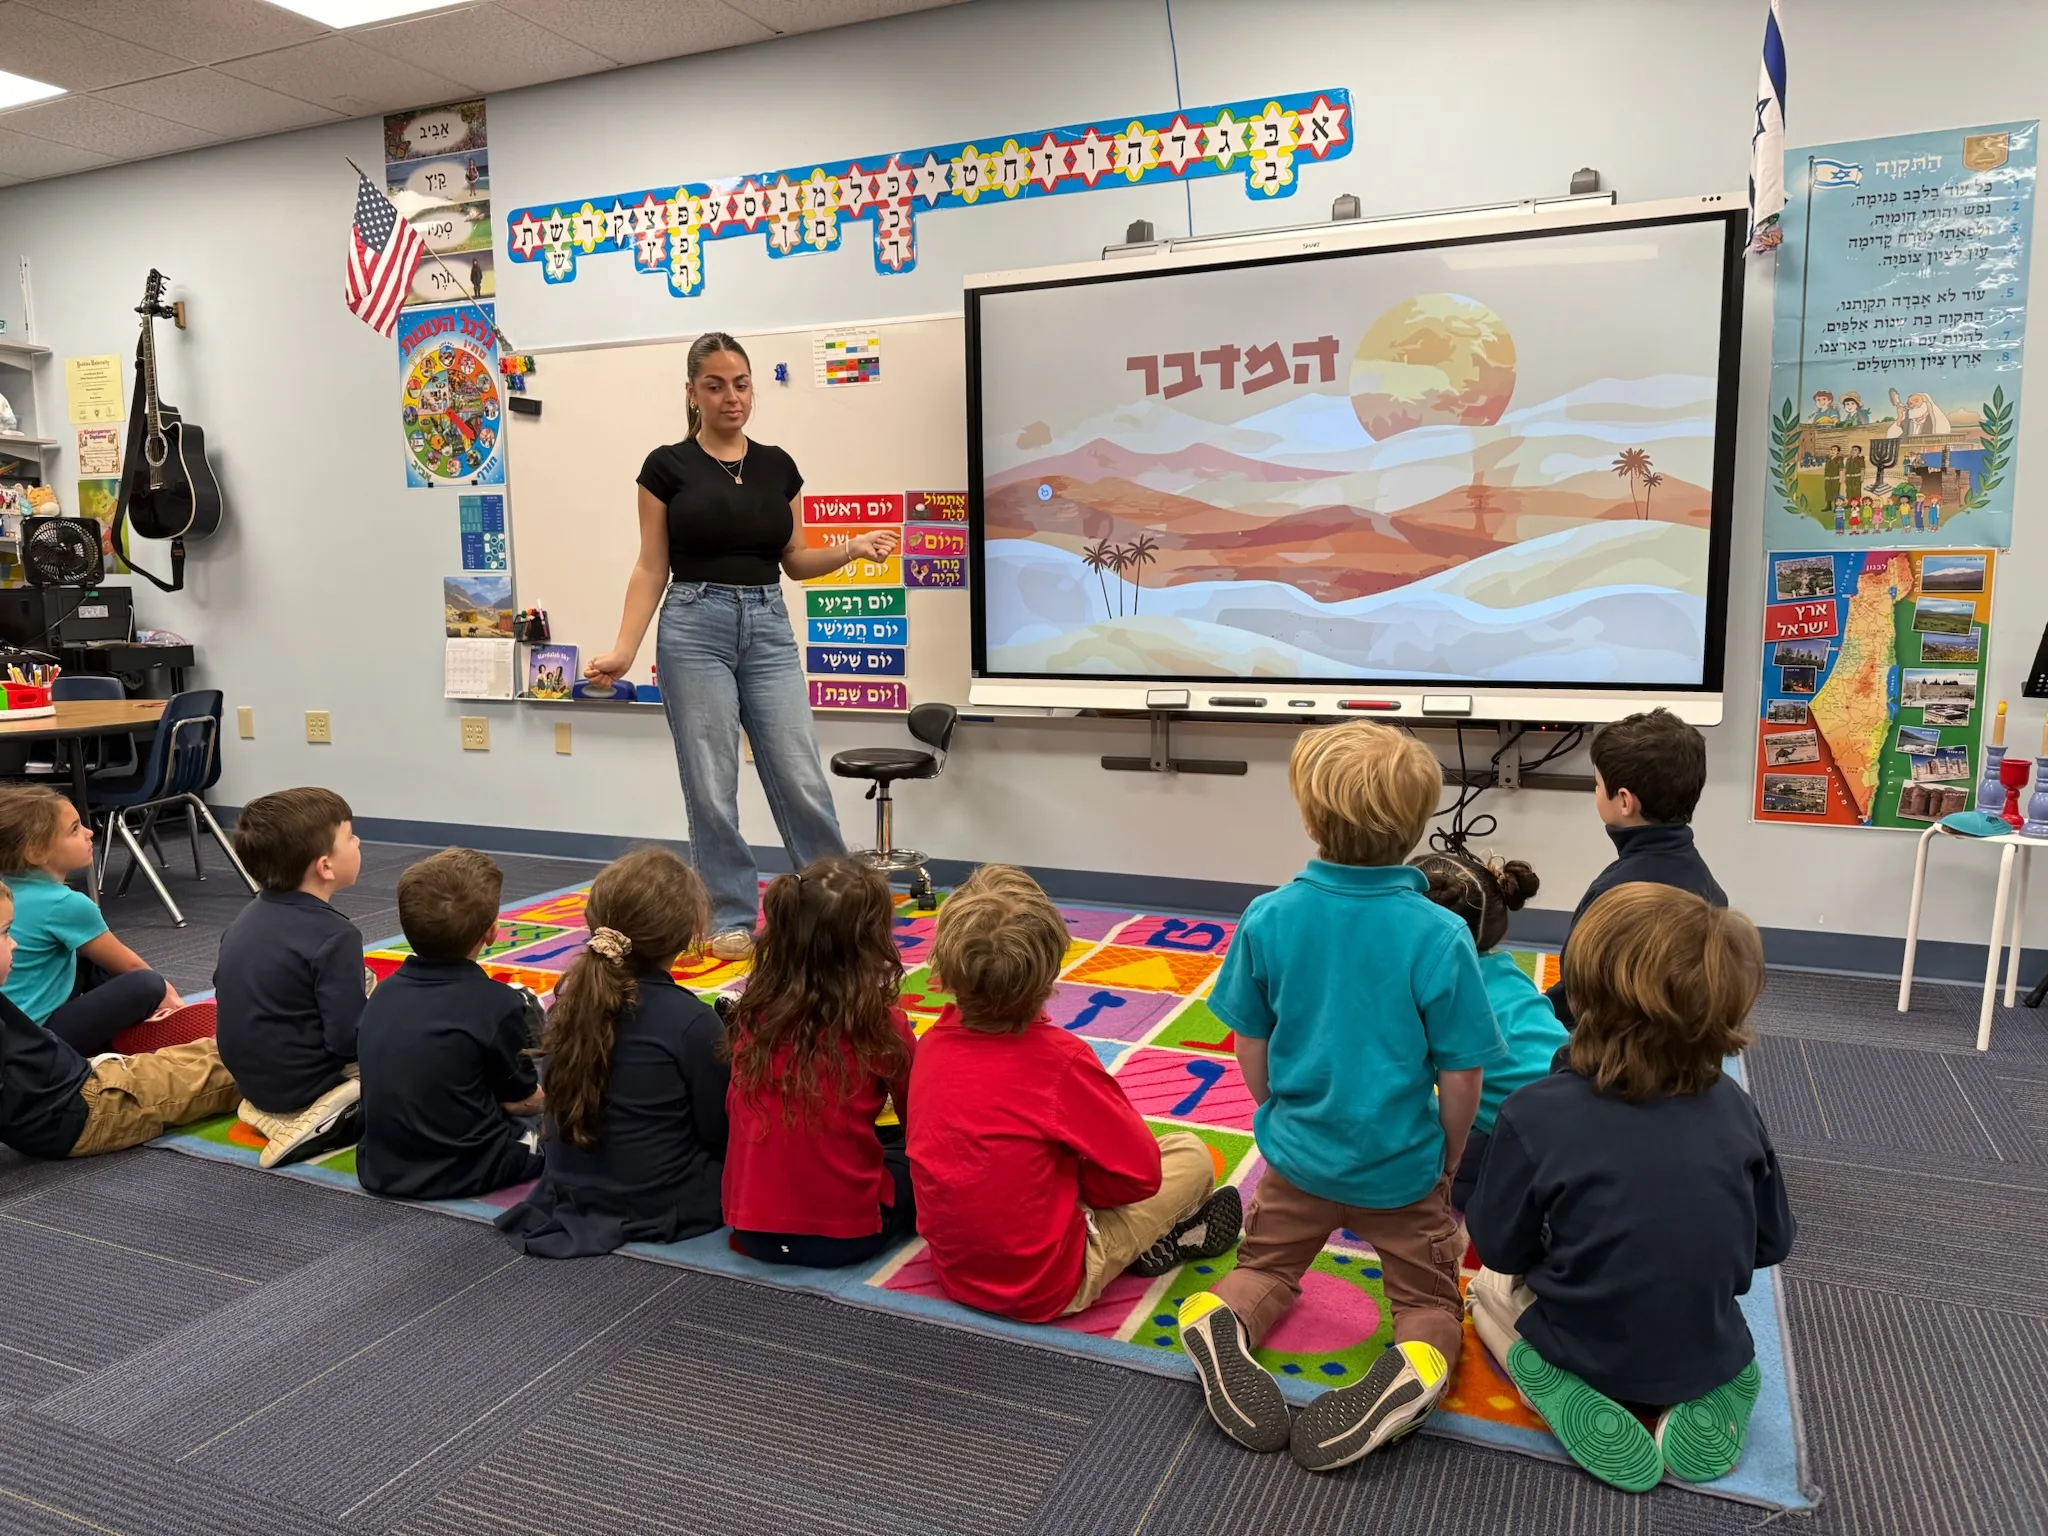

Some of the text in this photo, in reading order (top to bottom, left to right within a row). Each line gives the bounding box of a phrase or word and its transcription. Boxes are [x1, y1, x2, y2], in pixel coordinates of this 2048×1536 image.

[1312, 115, 1330, 142] א
[1172, 135, 1186, 158] ד
[1219, 130, 1230, 153] ג
[1088, 148, 1095, 170] ו
[1127, 142, 1142, 165] ה
[964, 164, 978, 186] ט
[1003, 158, 1017, 180] ח
[1045, 154, 1052, 175] ז
[1265, 161, 1278, 180] ב
[928, 171, 934, 183] י
[813, 187, 826, 208] מ
[850, 176, 862, 204] ל
[709, 201, 721, 223] ע
[745, 197, 756, 216] ס
[780, 192, 788, 212] נ
[583, 220, 594, 237] ר
[614, 215, 624, 243] ק
[644, 210, 655, 229] צ
[816, 220, 826, 237] ם
[889, 211, 900, 228] כ
[522, 228, 534, 246] ת
[550, 223, 563, 242] ש
[782, 225, 787, 247] ן
[647, 242, 656, 263] ץ
[680, 238, 689, 253] פ
[889, 241, 900, 263] ך
[679, 264, 689, 287] ף
[1126, 335, 1340, 400] המדבר
[1866, 563, 1887, 571] לבנון
[1795, 604, 1827, 621] ארץ
[1777, 621, 1828, 637] ישראל
